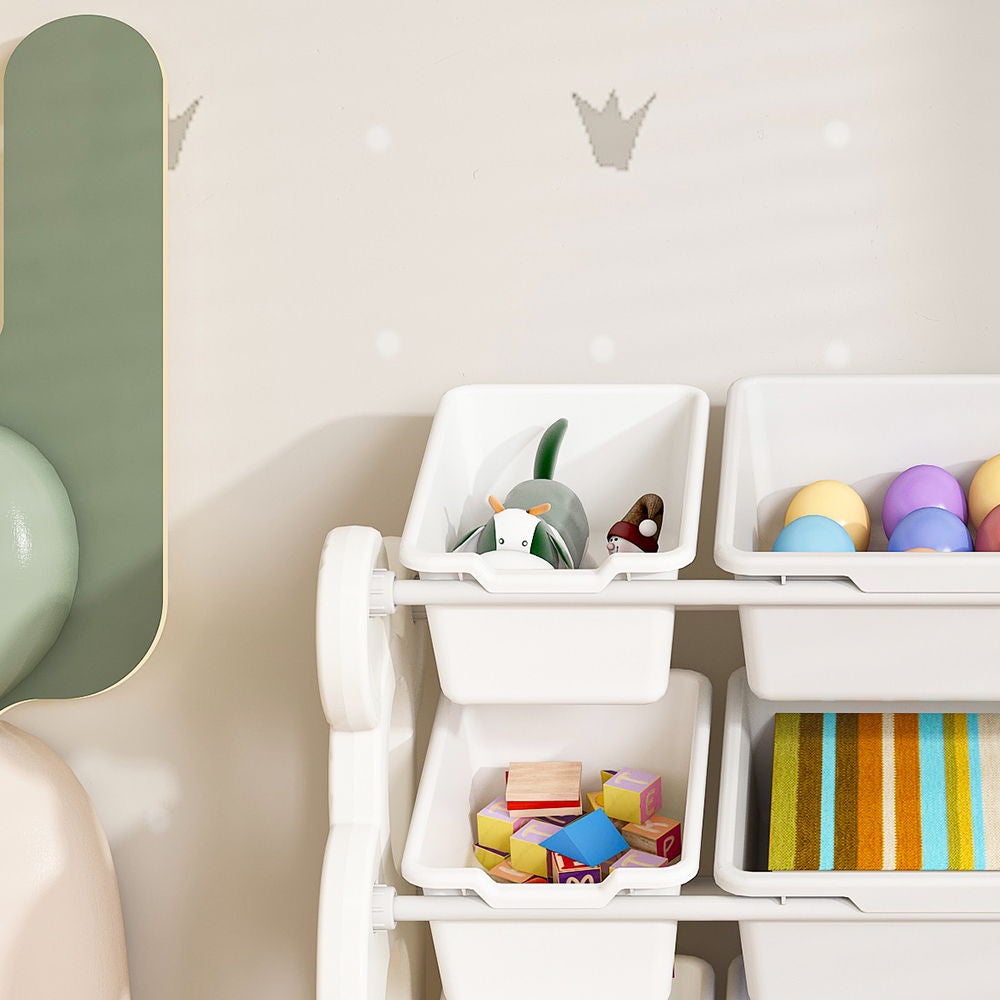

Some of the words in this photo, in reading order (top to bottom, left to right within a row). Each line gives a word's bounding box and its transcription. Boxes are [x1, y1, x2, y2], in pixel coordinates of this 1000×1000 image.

[614, 770, 649, 785] T
[646, 789, 656, 815] E
[663, 835, 675, 858] P
